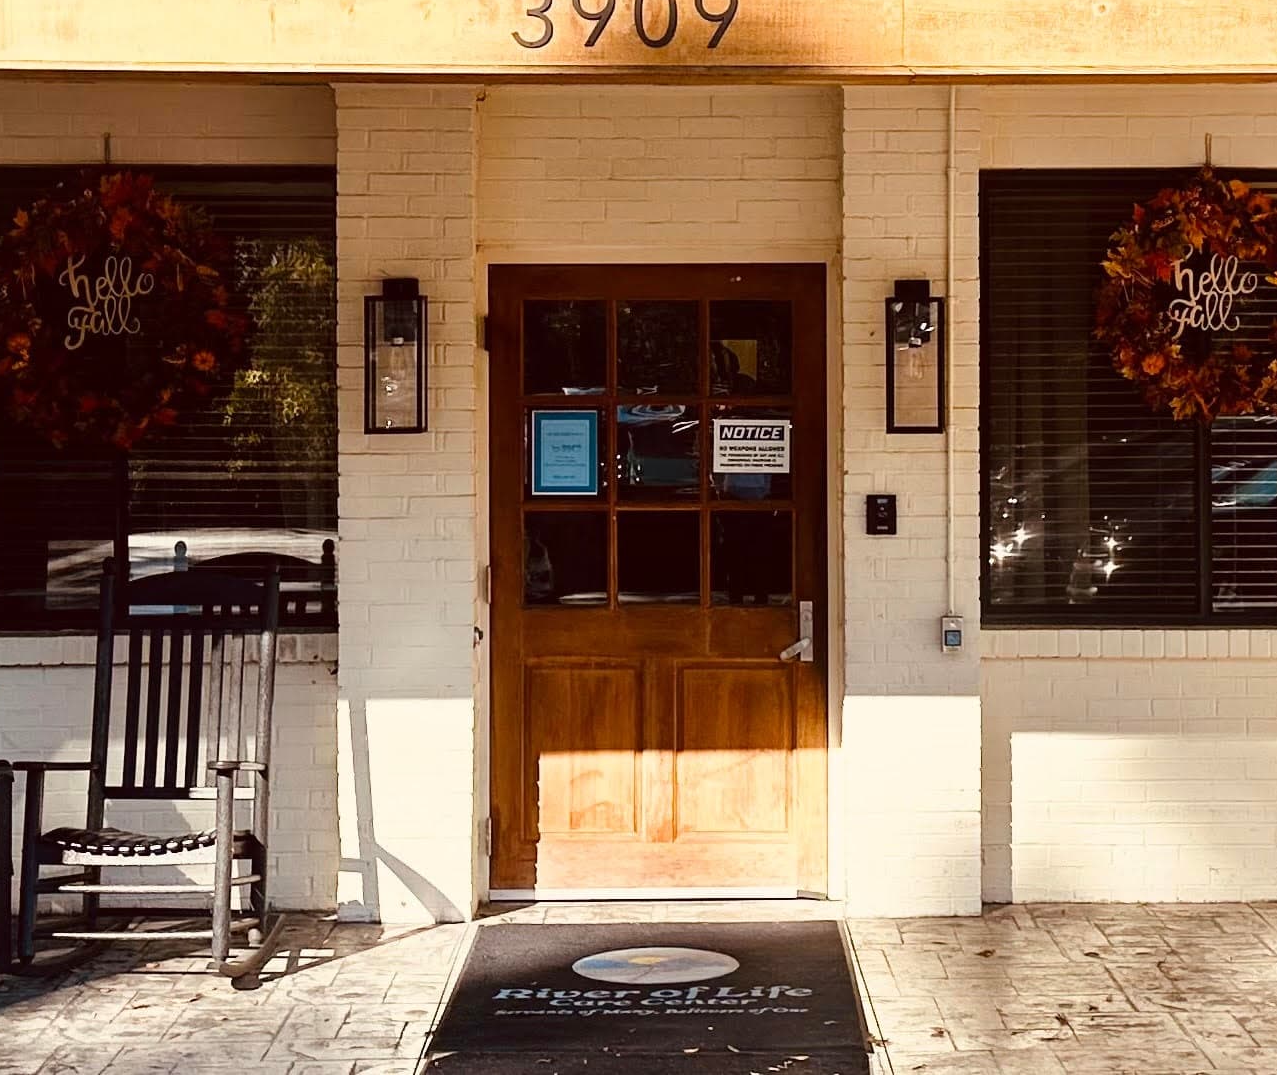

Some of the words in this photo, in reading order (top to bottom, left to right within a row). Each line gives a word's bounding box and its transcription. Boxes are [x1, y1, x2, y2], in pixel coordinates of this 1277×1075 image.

[1170, 243, 1258, 301] hello
[59, 254, 155, 306] hello
[721, 426, 783, 439] NOTICE
[491, 988, 641, 999] River
[650, 986, 711, 999] of
[714, 985, 813, 999] Life
[549, 998, 632, 1006] Care
[640, 998, 758, 1006] Center
[578, 1009, 602, 1017] of
[748, 1007, 772, 1015] of
